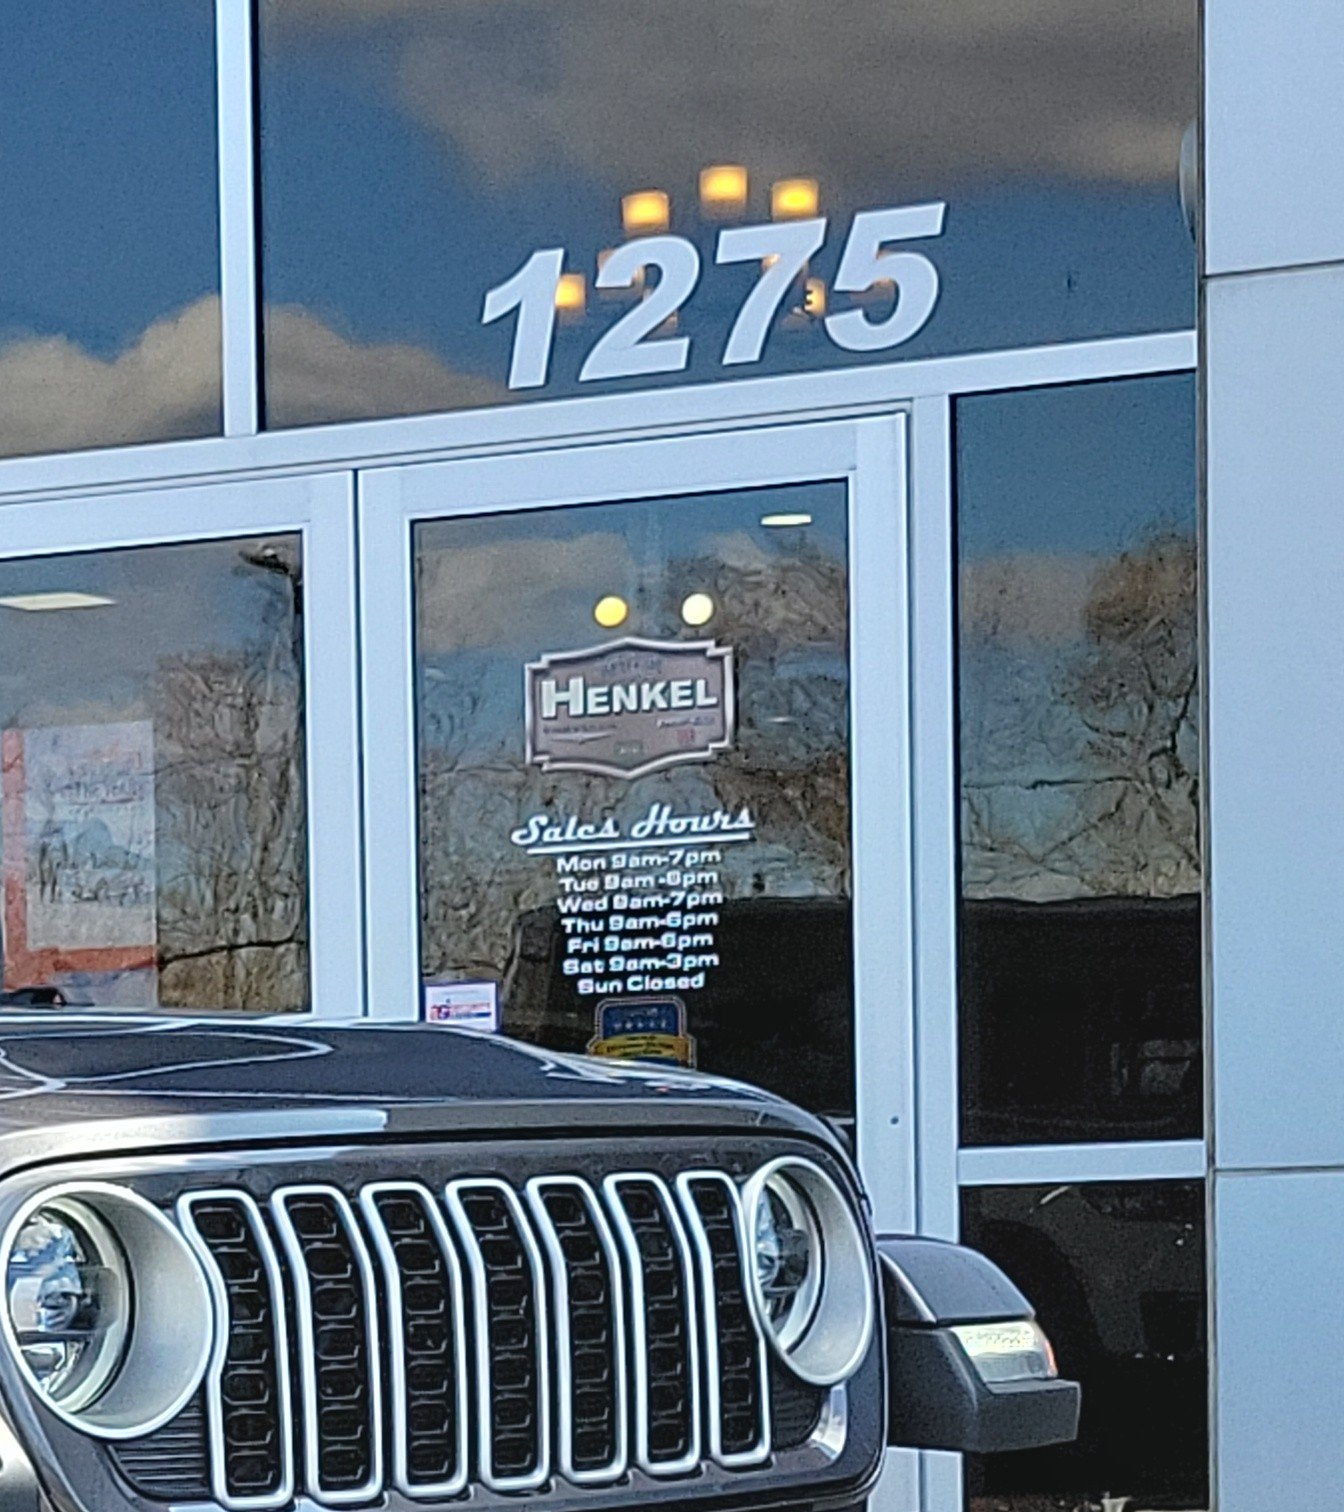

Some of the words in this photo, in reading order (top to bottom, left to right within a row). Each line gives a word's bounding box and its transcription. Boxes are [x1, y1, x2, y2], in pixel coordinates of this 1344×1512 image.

[482, 202, 947, 389] 1275
[541, 676, 718, 718] HENKEL
[511, 814, 620, 845] Sales
[631, 803, 755, 838] Hours
[557, 855, 607, 873] Mon
[611, 850, 722, 868] 9am-7pm
[559, 877, 599, 893] Tue
[557, 895, 608, 913] Wed
[613, 891, 723, 909] 9am-7pm
[561, 917, 604, 933] Thu
[609, 911, 719, 930] 9am-6pm
[567, 936, 600, 953] Fri
[603, 932, 713, 951] 9am-6pm
[563, 958, 605, 975] Sat
[609, 953, 719, 971] 9am-3pm
[577, 978, 623, 994] Sun
[626, 972, 705, 991] Closed
